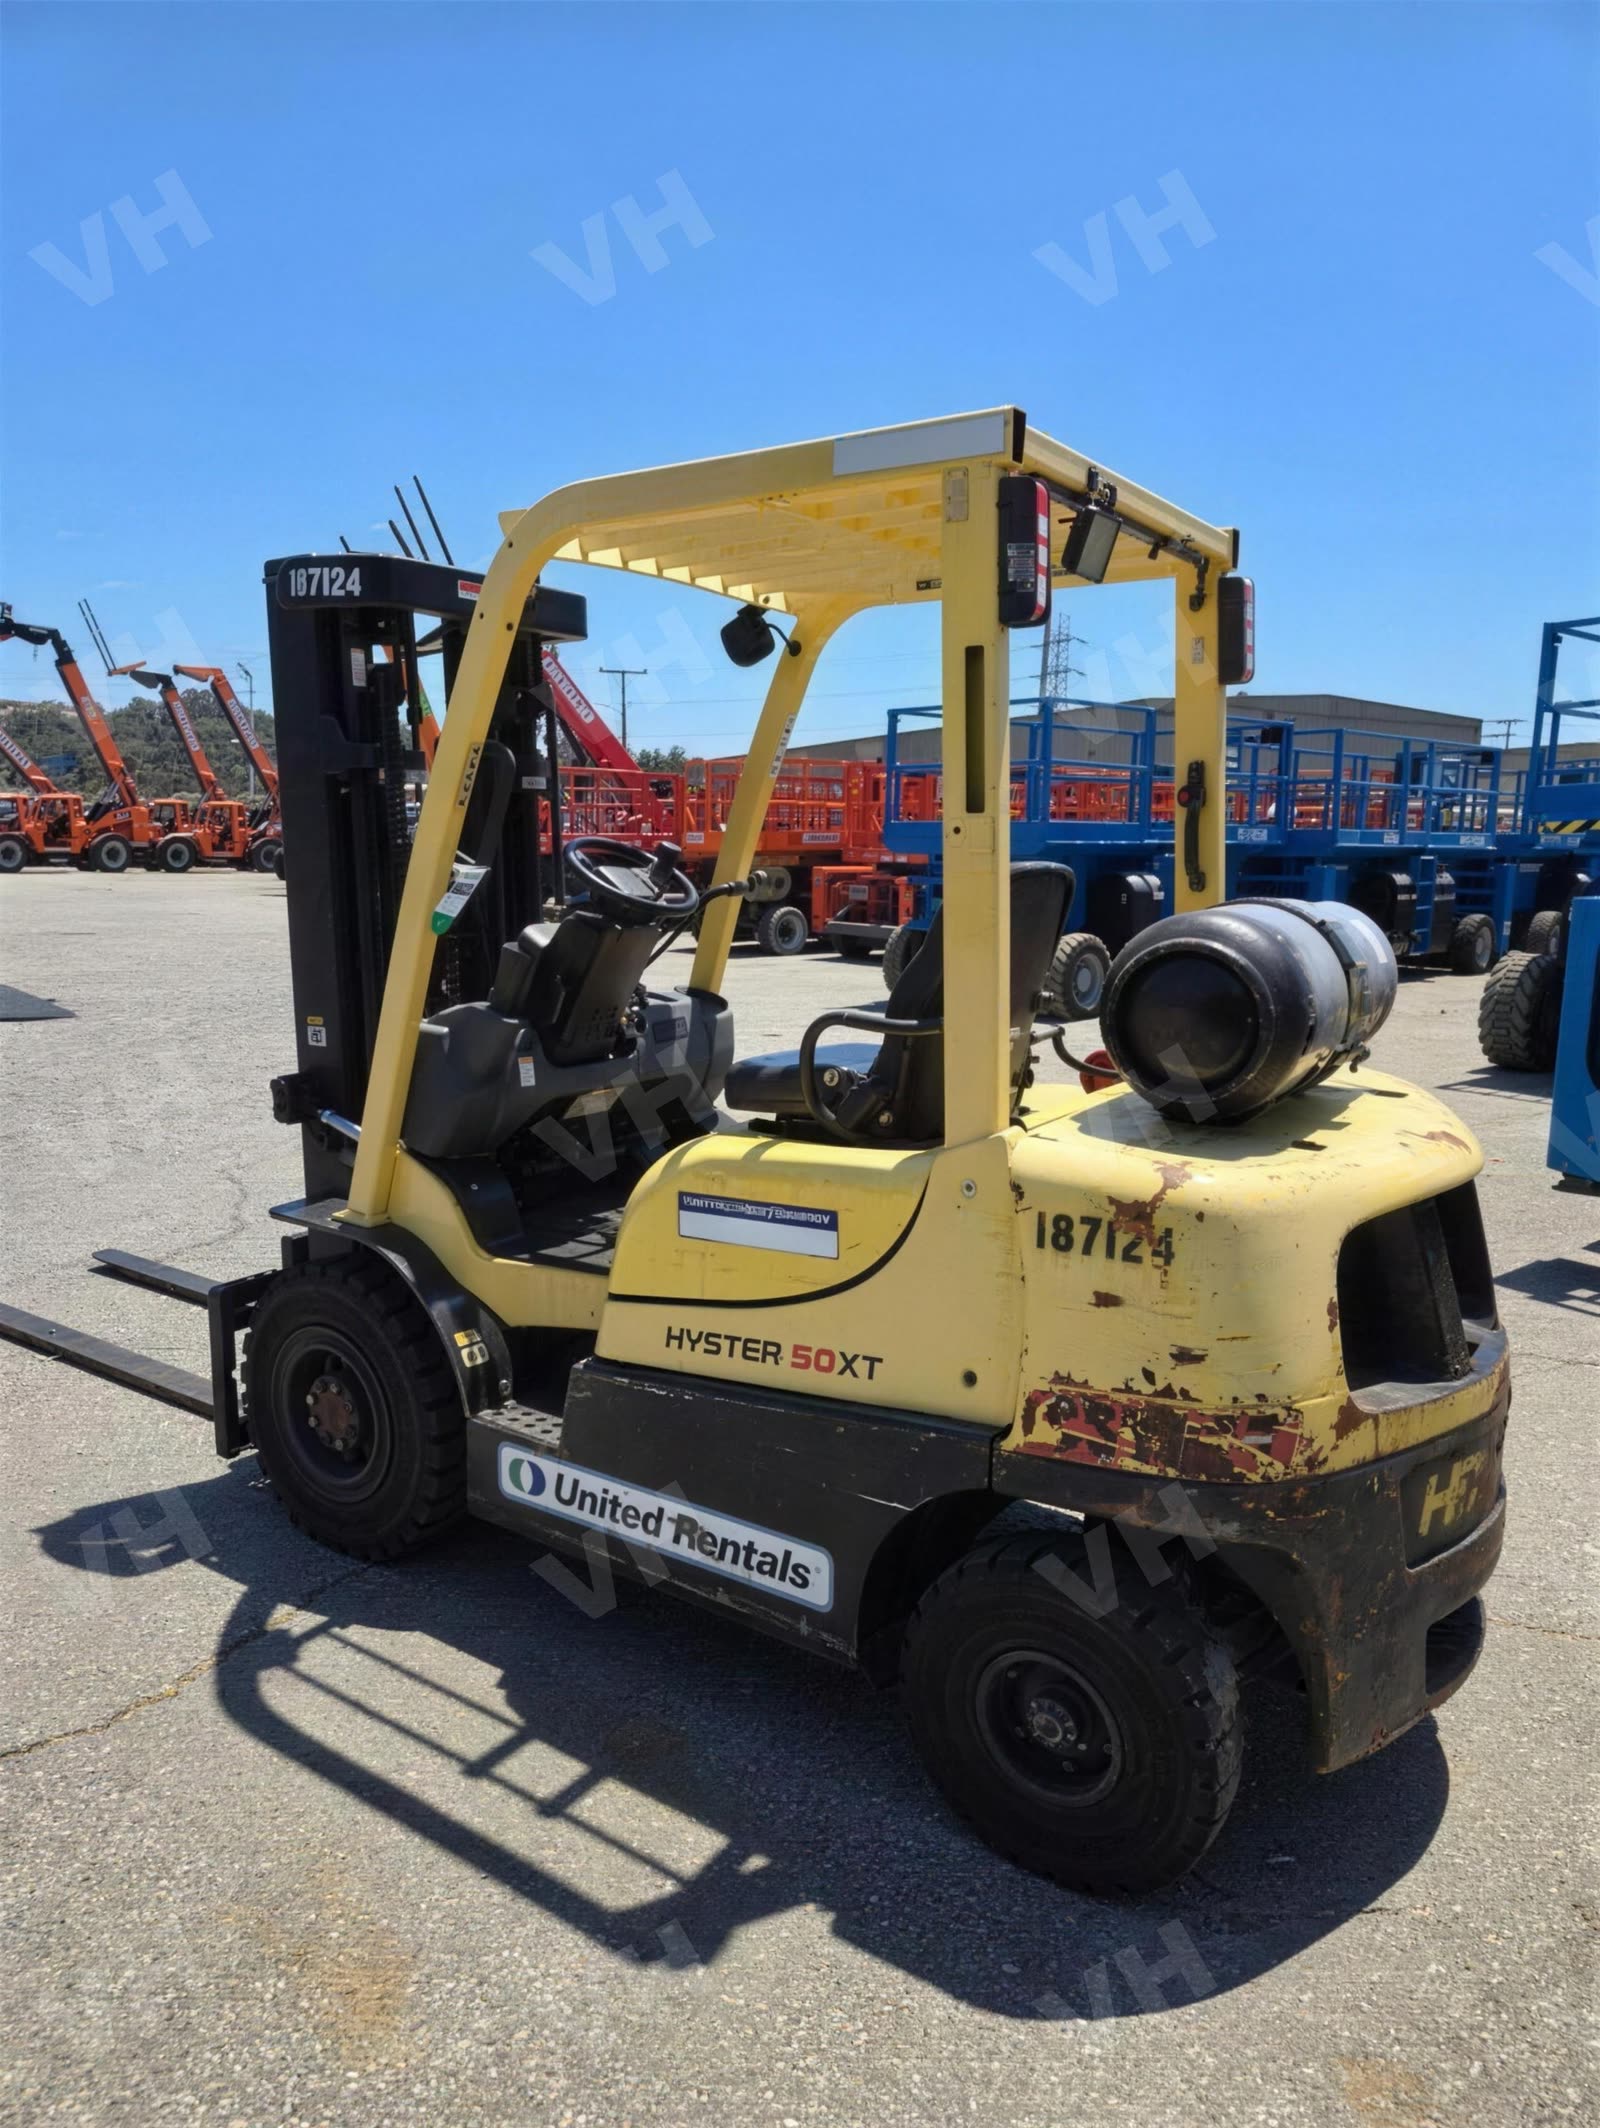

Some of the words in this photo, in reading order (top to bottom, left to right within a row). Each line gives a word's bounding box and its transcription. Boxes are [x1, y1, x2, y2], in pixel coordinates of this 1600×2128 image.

[288, 567, 362, 597] 187124
[1036, 1211, 1175, 1267] 187124
[665, 1326, 784, 1366] HYSTER
[790, 1343, 884, 1381] 50XT
[554, 1472, 665, 1538] United
[672, 1512, 812, 1590] Rentals
